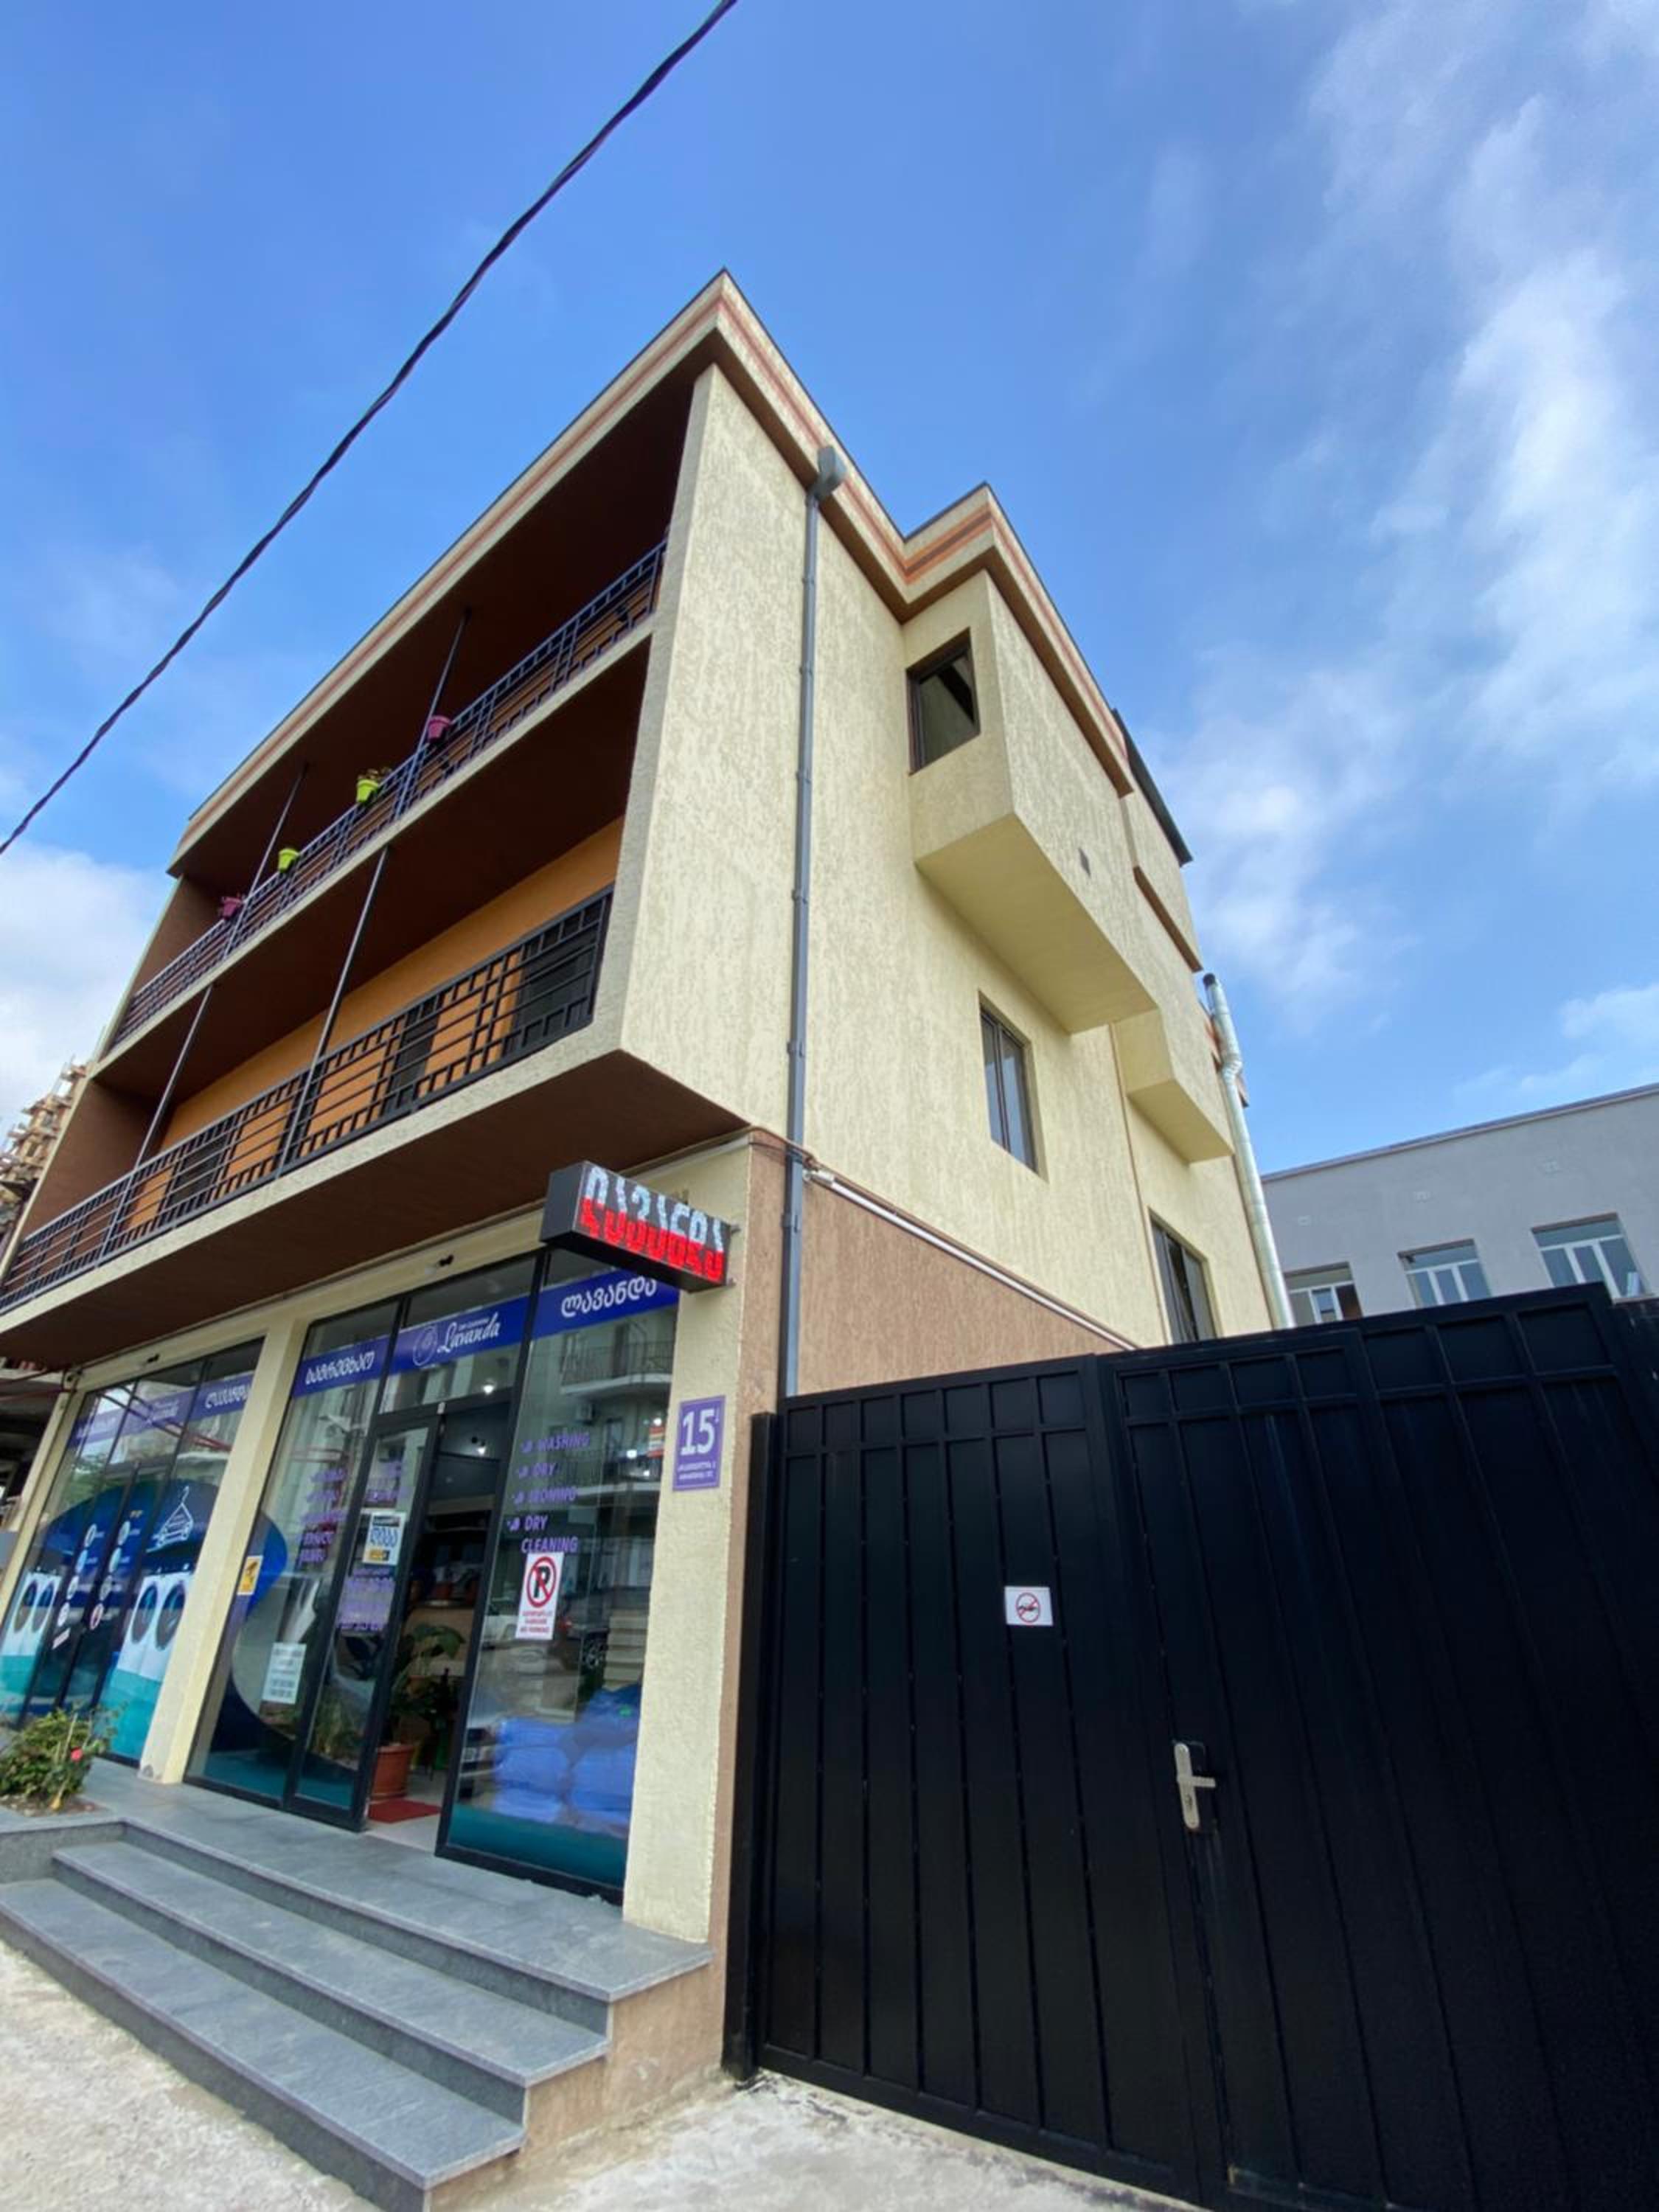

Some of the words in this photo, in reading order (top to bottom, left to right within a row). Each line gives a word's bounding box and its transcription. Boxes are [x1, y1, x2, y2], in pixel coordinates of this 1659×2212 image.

[560, 1275, 657, 1318] ლავანდა
[437, 1312, 501, 1354] Lavanda
[680, 1408, 716, 1456] 15
[524, 1515, 549, 1531] DRY
[521, 1536, 578, 1554] CLEANING
